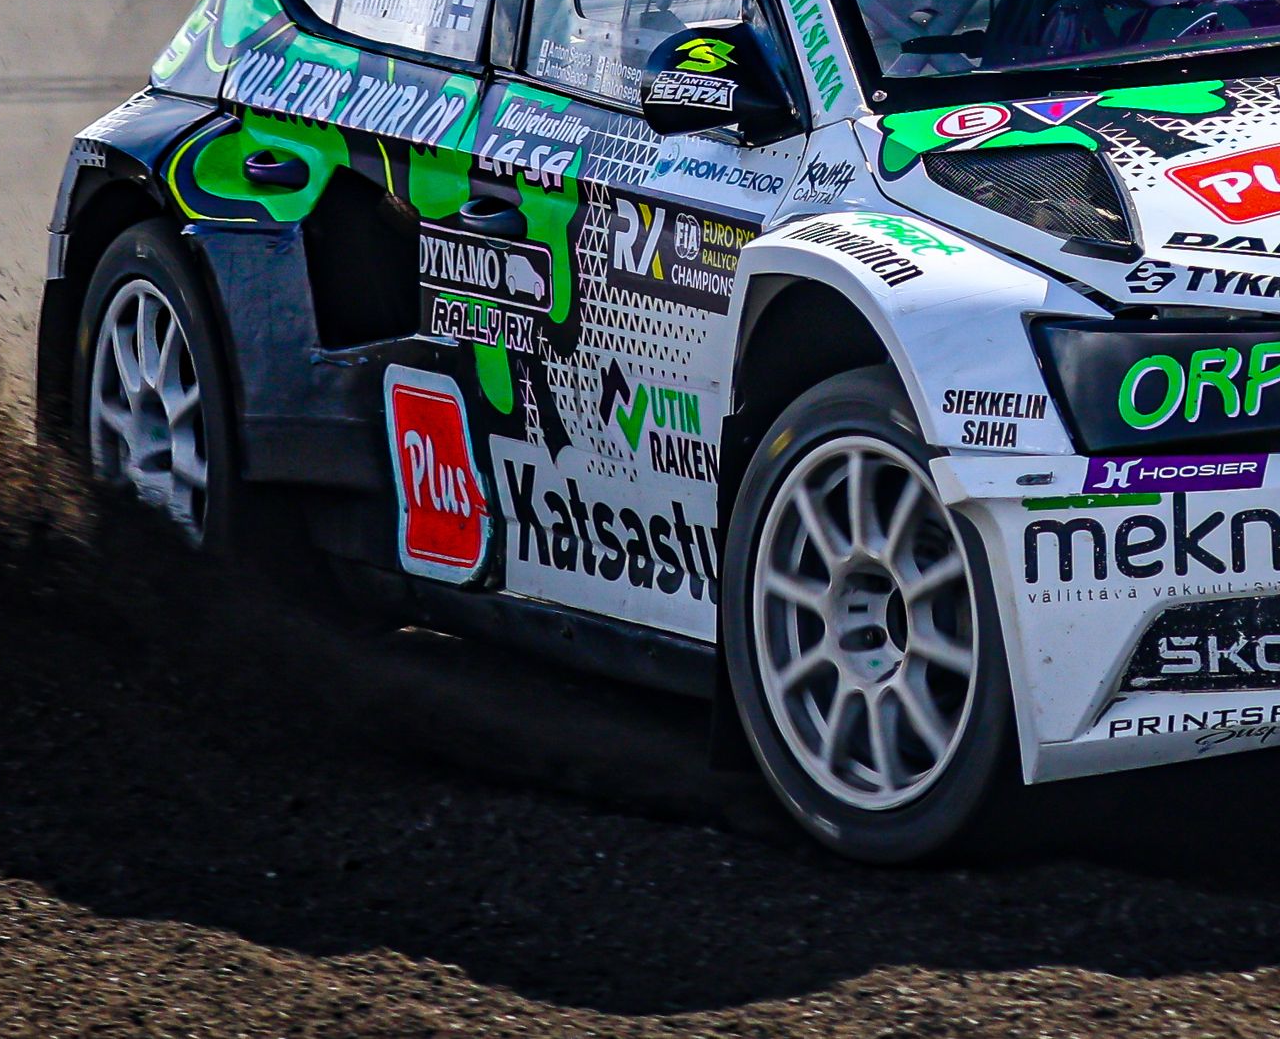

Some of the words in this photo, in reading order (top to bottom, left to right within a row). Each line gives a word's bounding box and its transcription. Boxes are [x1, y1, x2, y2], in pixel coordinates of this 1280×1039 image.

[223, 49, 350, 118] KULJETUS
[335, 74, 427, 134] TUURI
[418, 95, 466, 146] OY
[682, 78, 721, 87] ANTON
[497, 102, 591, 146] Kuljetusliike
[478, 135, 574, 189] LA-SA
[674, 159, 785, 195] AROM-DEKOR
[793, 187, 836, 205] CAPITAL
[704, 220, 734, 248] EURO
[420, 234, 500, 289] DYNAMO
[431, 297, 501, 346] RALLY
[505, 312, 534, 354] RX
[650, 386, 701, 436] UTIN
[942, 389, 1048, 420] SIEKKELIN
[961, 420, 1018, 448] SAHA
[403, 429, 471, 518] Plus
[649, 431, 719, 484] RAKEN
[1138, 461, 1258, 481] HOOSIER
